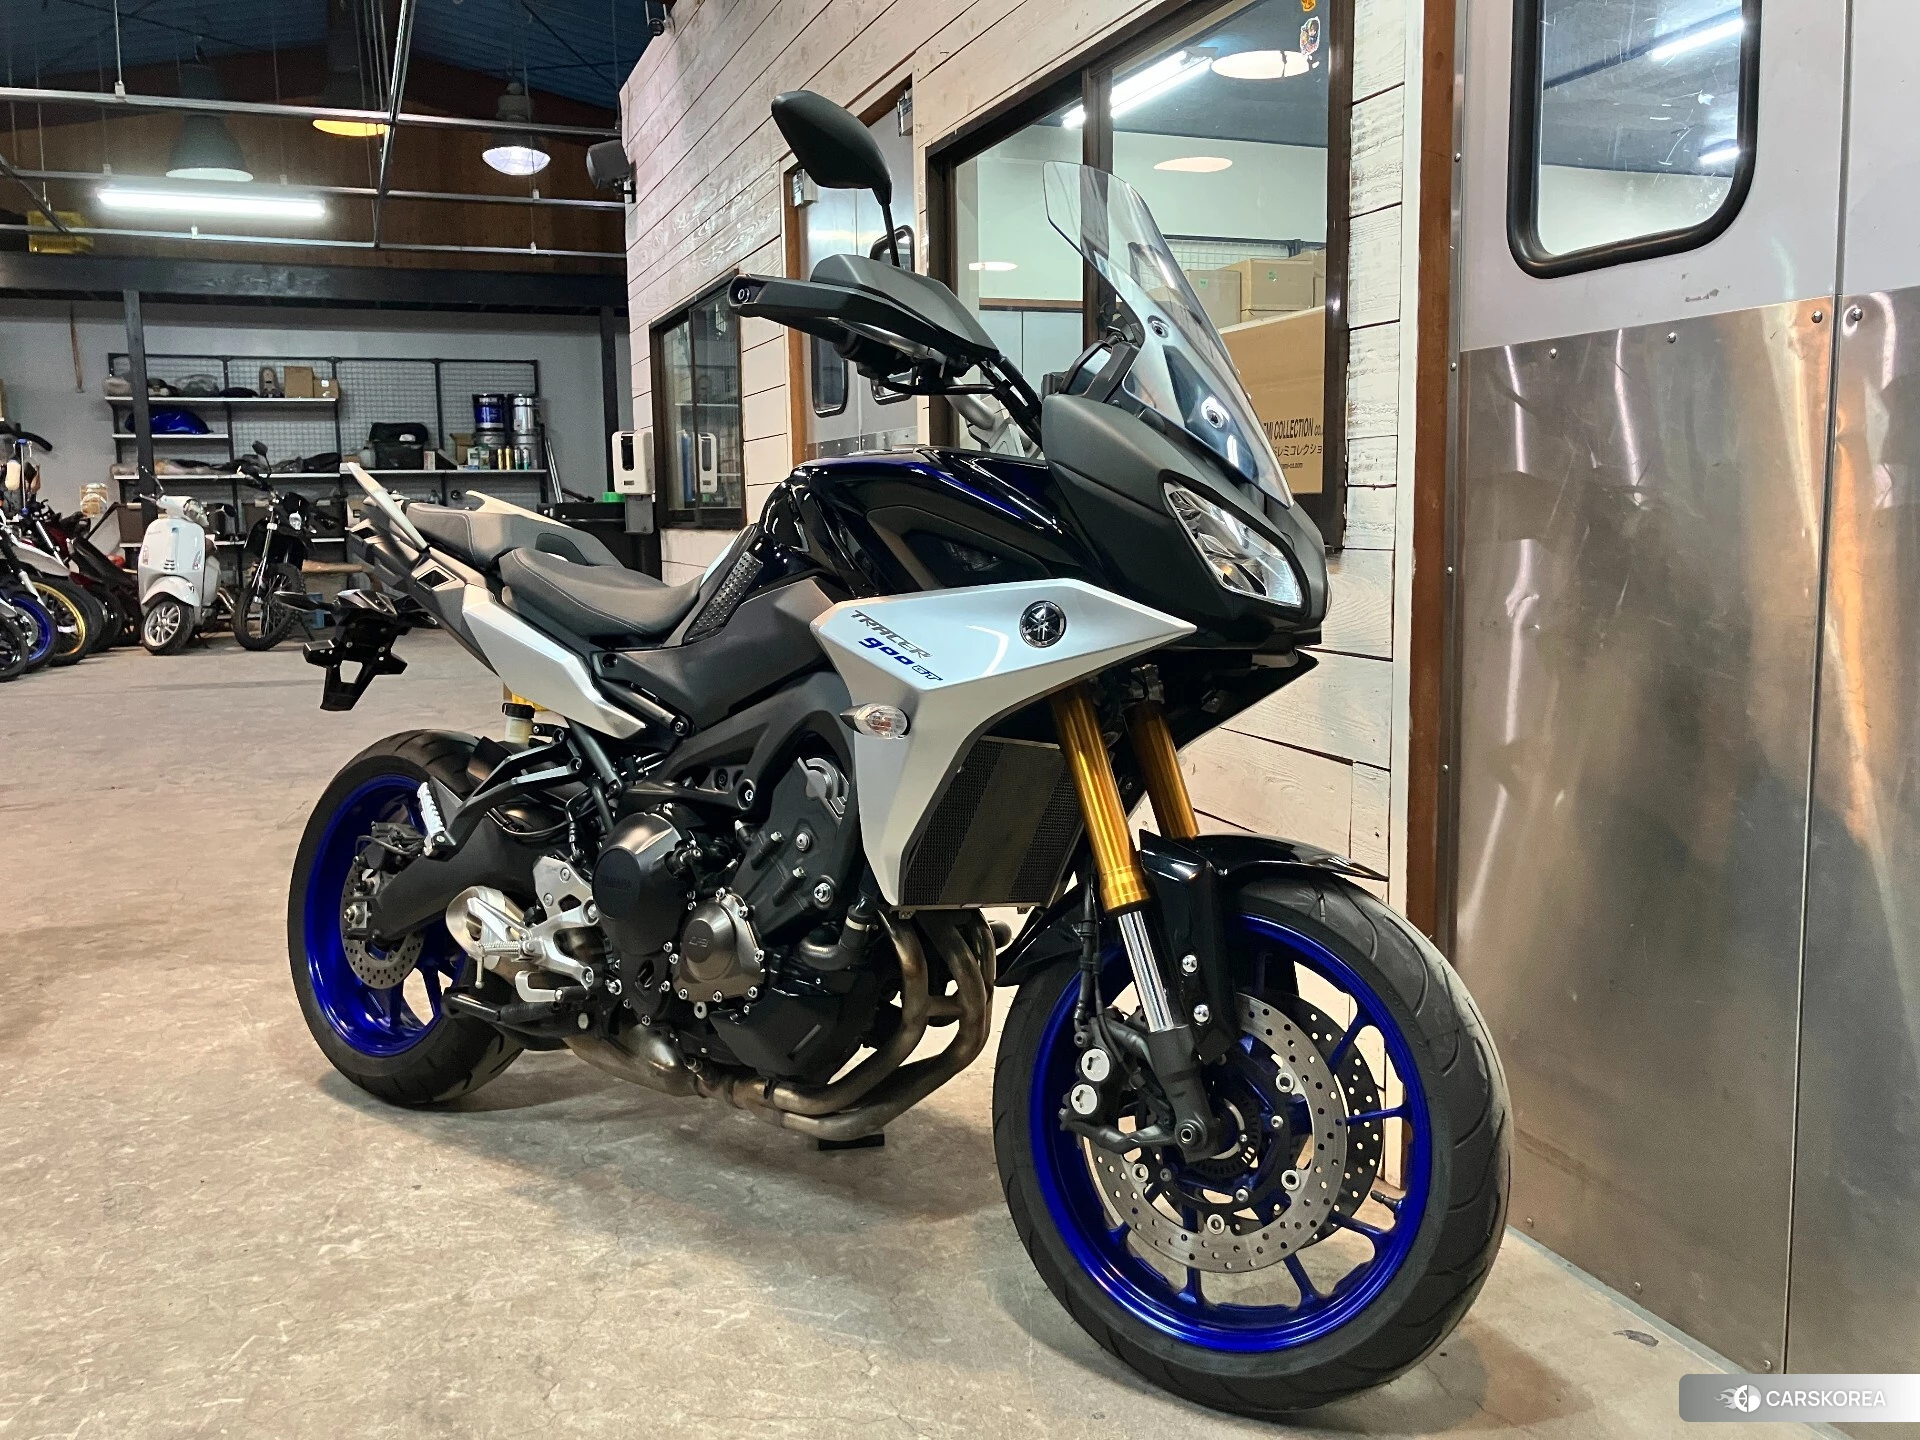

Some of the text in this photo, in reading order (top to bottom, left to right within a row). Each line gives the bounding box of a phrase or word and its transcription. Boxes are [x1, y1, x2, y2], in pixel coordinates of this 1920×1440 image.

[1274, 418, 1314, 440] COLLECTION
[851, 609, 933, 659] TRACER
[858, 637, 943, 681] 900 GT
